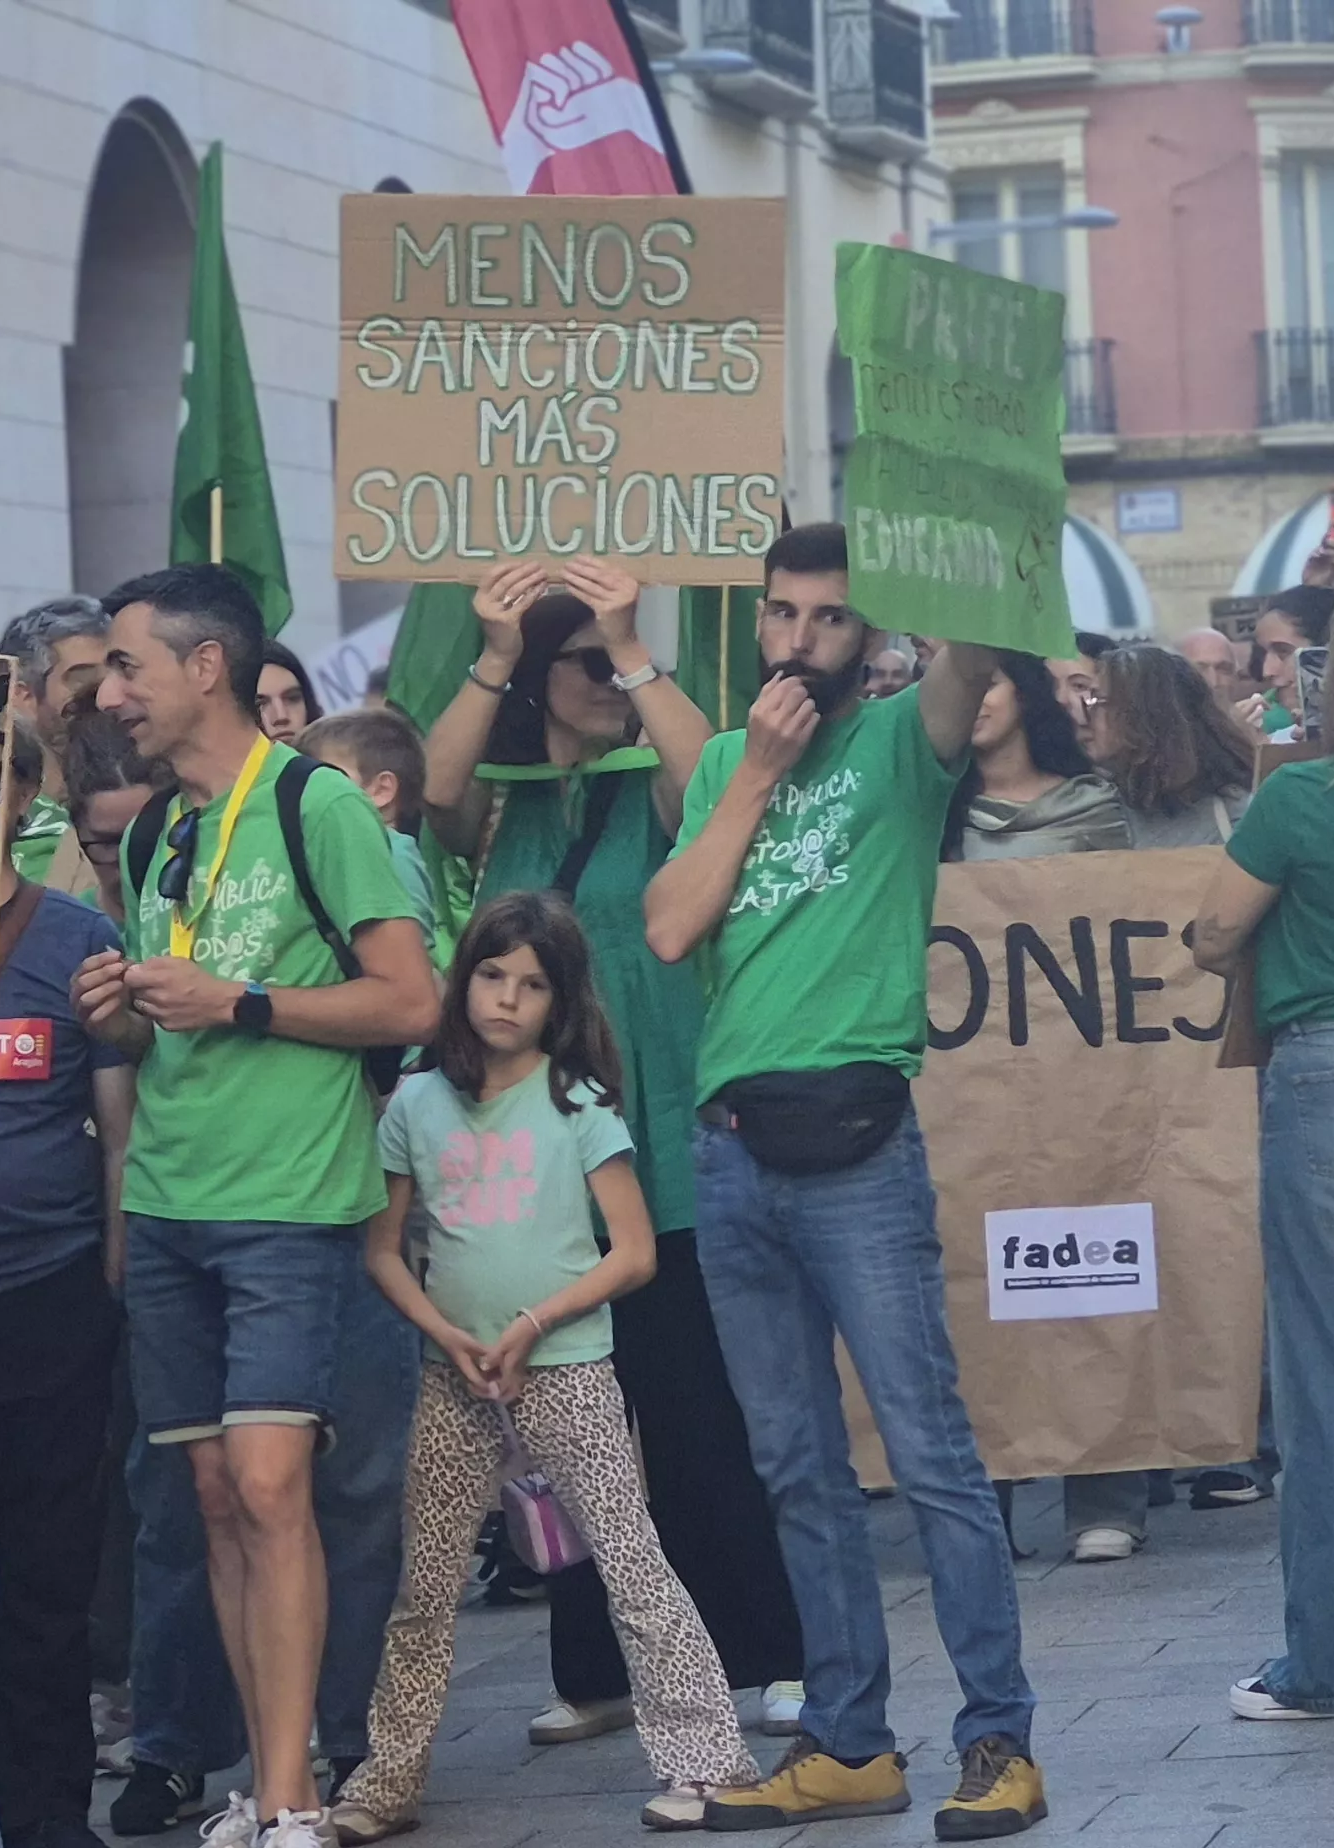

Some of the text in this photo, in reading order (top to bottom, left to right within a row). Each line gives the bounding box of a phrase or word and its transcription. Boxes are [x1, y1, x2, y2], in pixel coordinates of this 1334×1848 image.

[393, 220, 696, 309] MENOS
[478, 390, 620, 467] MÁS
[1002, 1232, 1140, 1270] fadea
